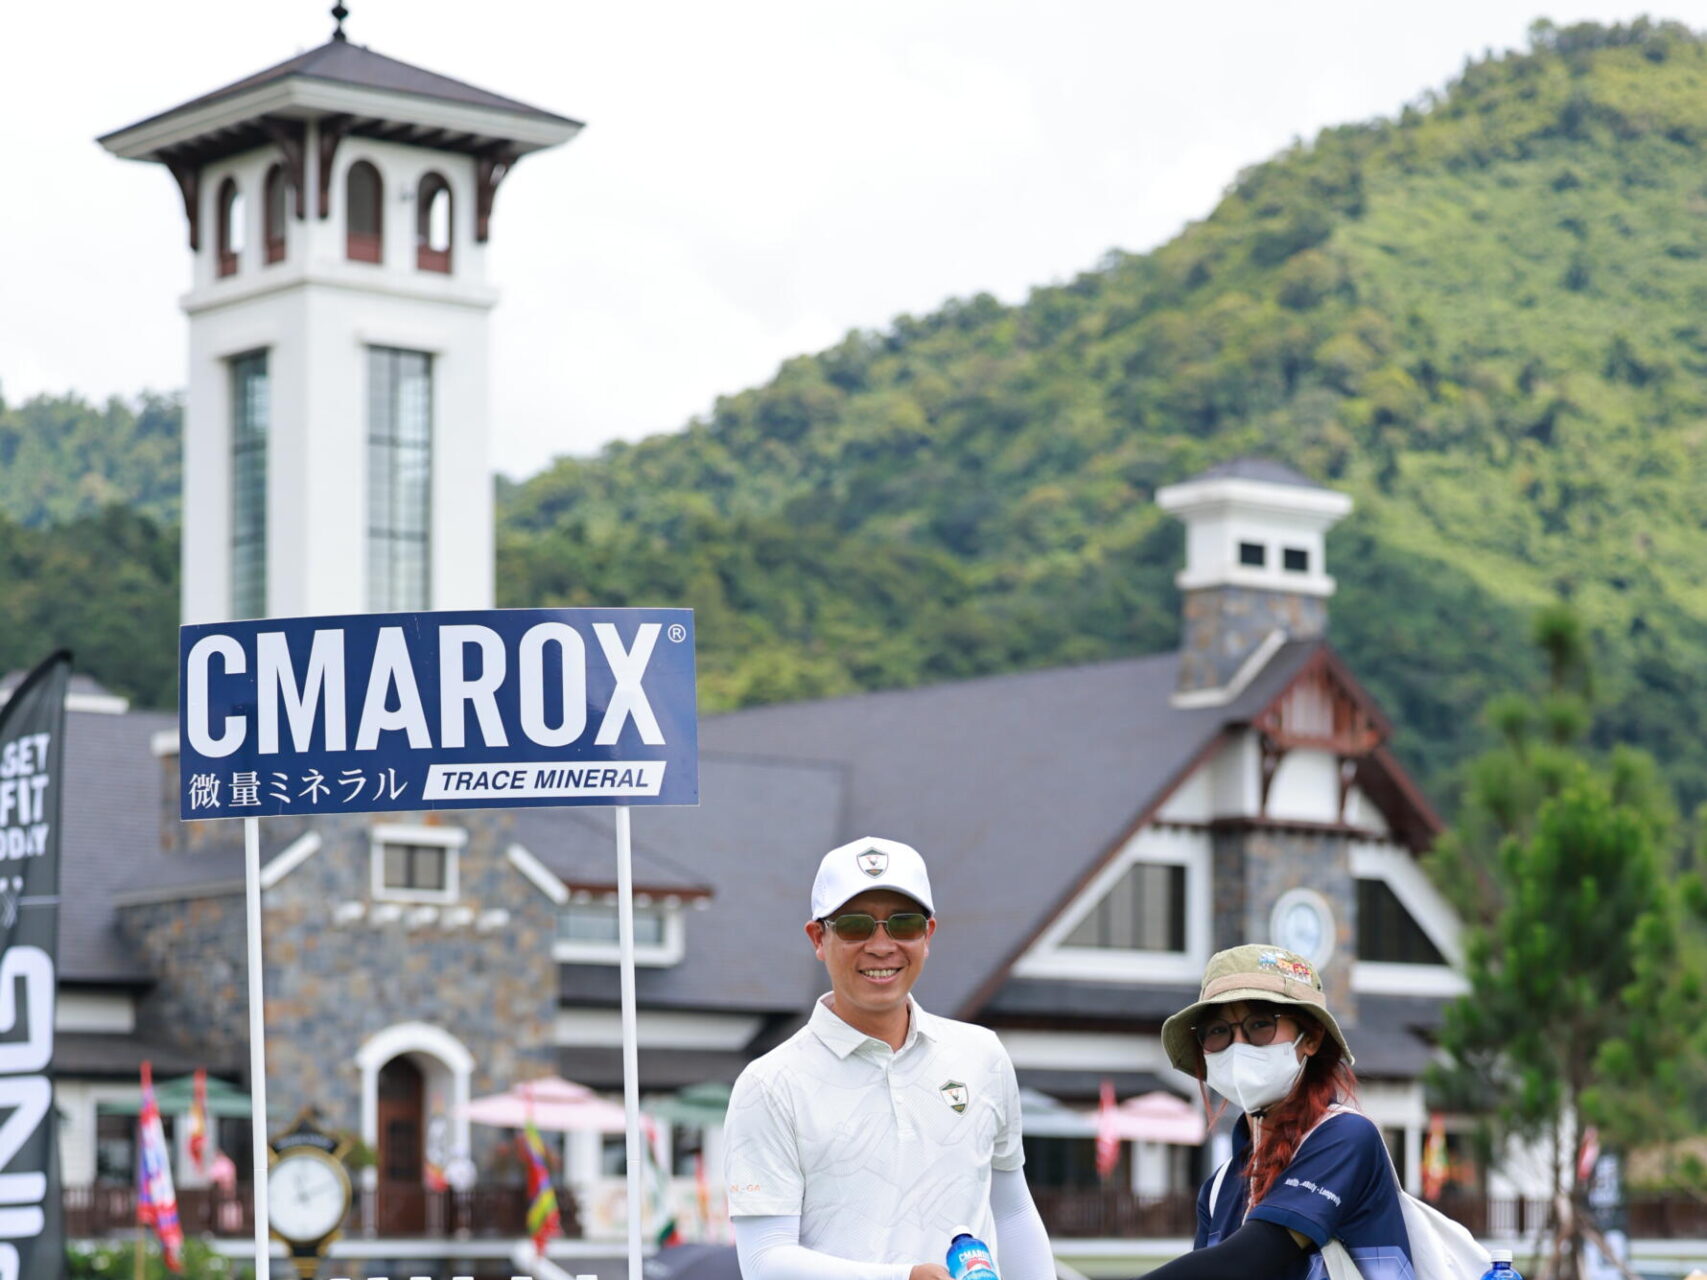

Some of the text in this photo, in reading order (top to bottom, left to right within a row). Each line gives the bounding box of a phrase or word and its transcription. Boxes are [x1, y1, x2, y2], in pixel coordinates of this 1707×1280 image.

[186, 620, 667, 758] CMAROX
[188, 766, 409, 811] 微量ミネラル
[440, 767, 650, 791] TRACE MINERAL
